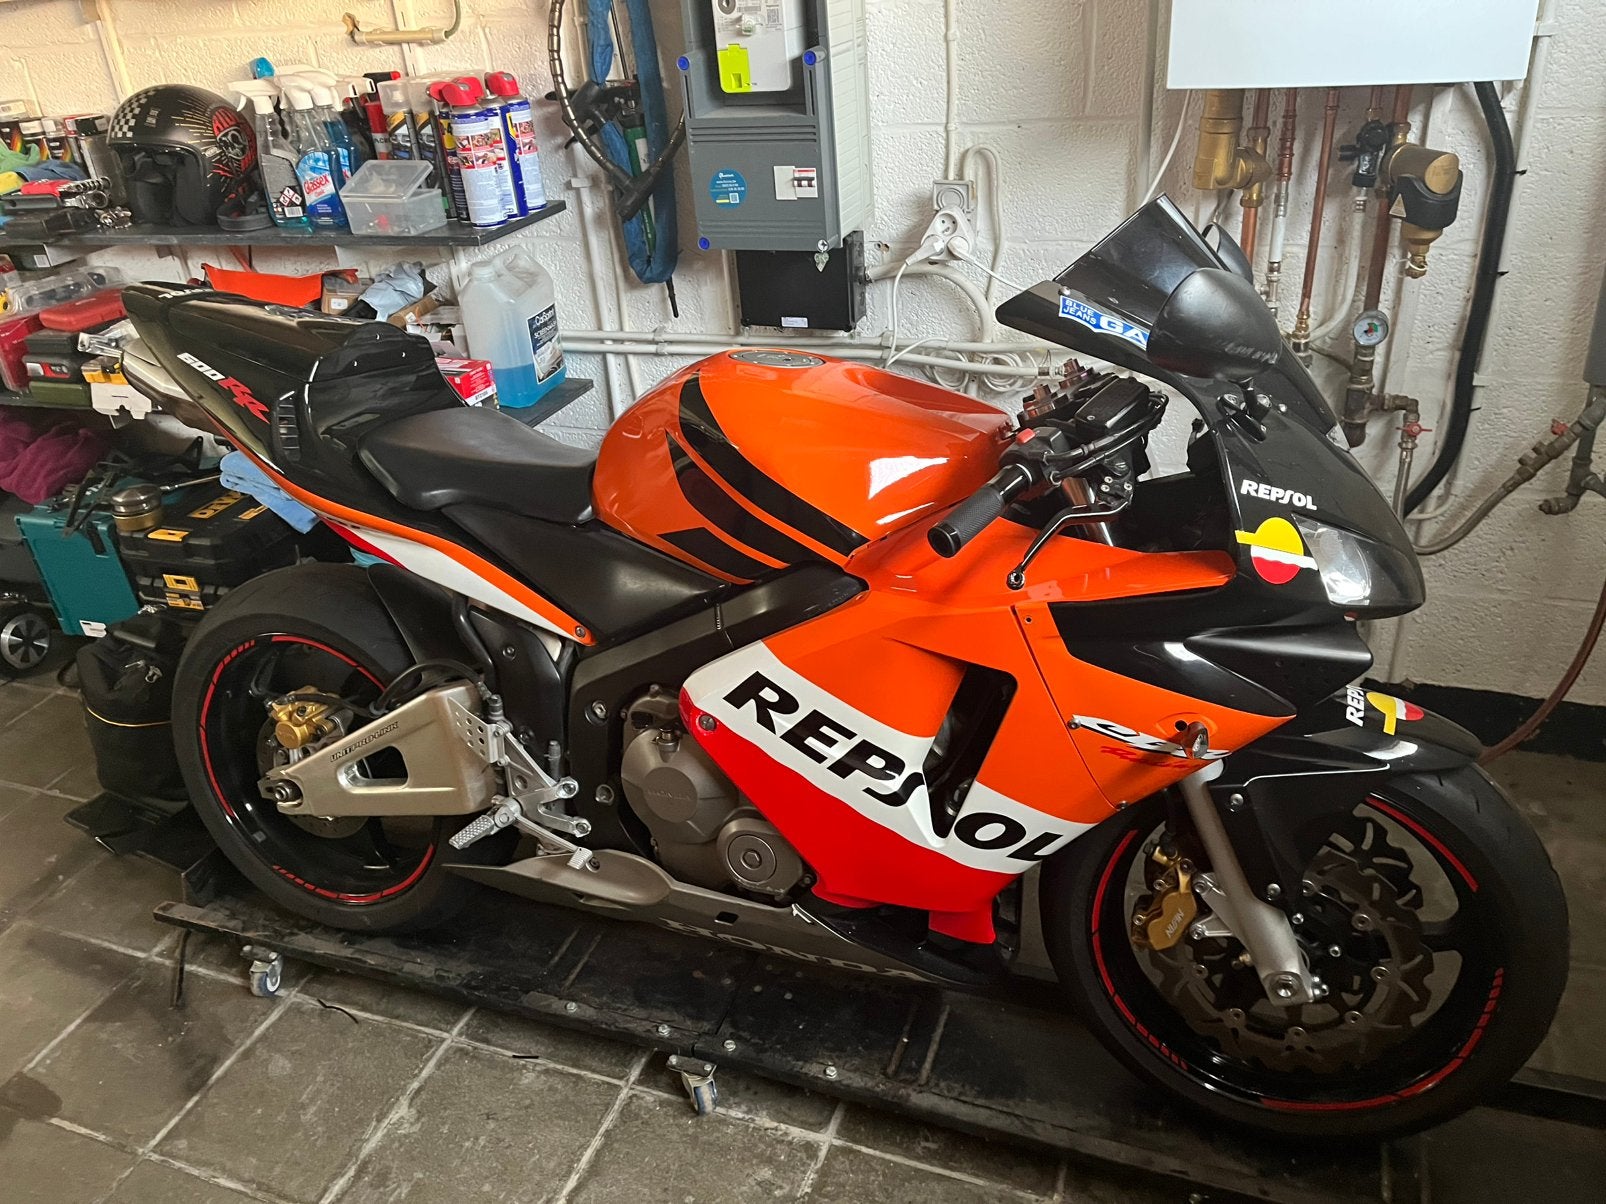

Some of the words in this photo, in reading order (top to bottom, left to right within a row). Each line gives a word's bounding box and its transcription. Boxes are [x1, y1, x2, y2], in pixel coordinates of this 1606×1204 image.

[1063, 306, 1097, 325] JEANS
[1065, 299, 1094, 317] BLUE
[1100, 315, 1146, 346] GA
[1241, 479, 1318, 511] REPSOL
[723, 671, 1063, 862] REPSOL
[658, 917, 938, 984] HONDA
